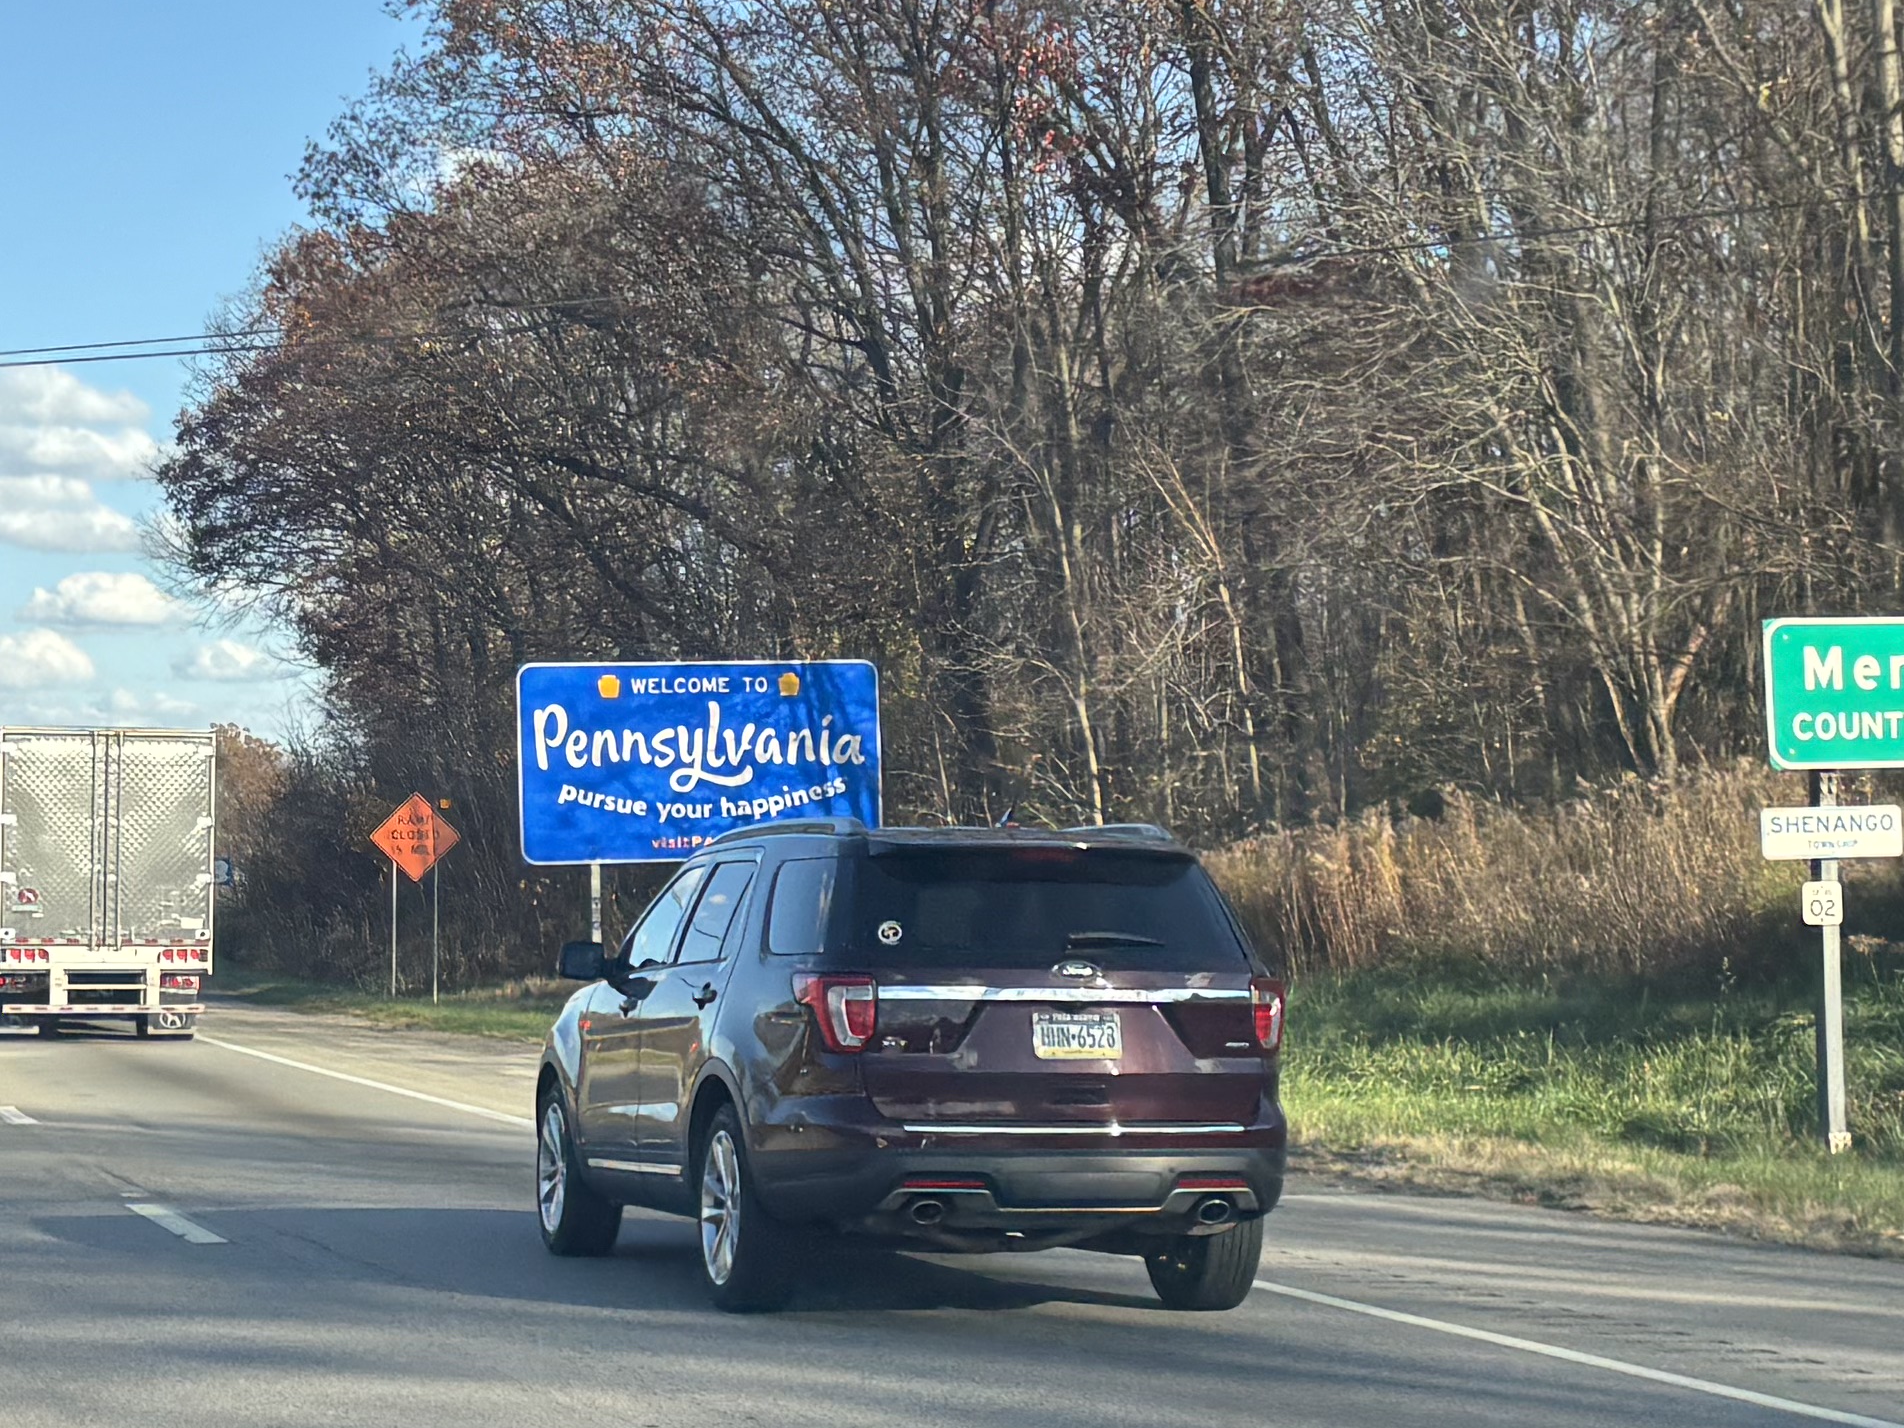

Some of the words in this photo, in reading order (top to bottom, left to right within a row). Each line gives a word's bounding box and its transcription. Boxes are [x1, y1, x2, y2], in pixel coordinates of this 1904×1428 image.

[631, 676, 730, 694] WELCOME
[742, 676, 768, 693] TO
[533, 700, 865, 793] Pennsylvania
[557, 783, 648, 816] pursue
[656, 800, 714, 823] your
[721, 777, 847, 820] happiness
[1770, 814, 1893, 834] SHENANGO
[1810, 899, 1836, 917] 02
